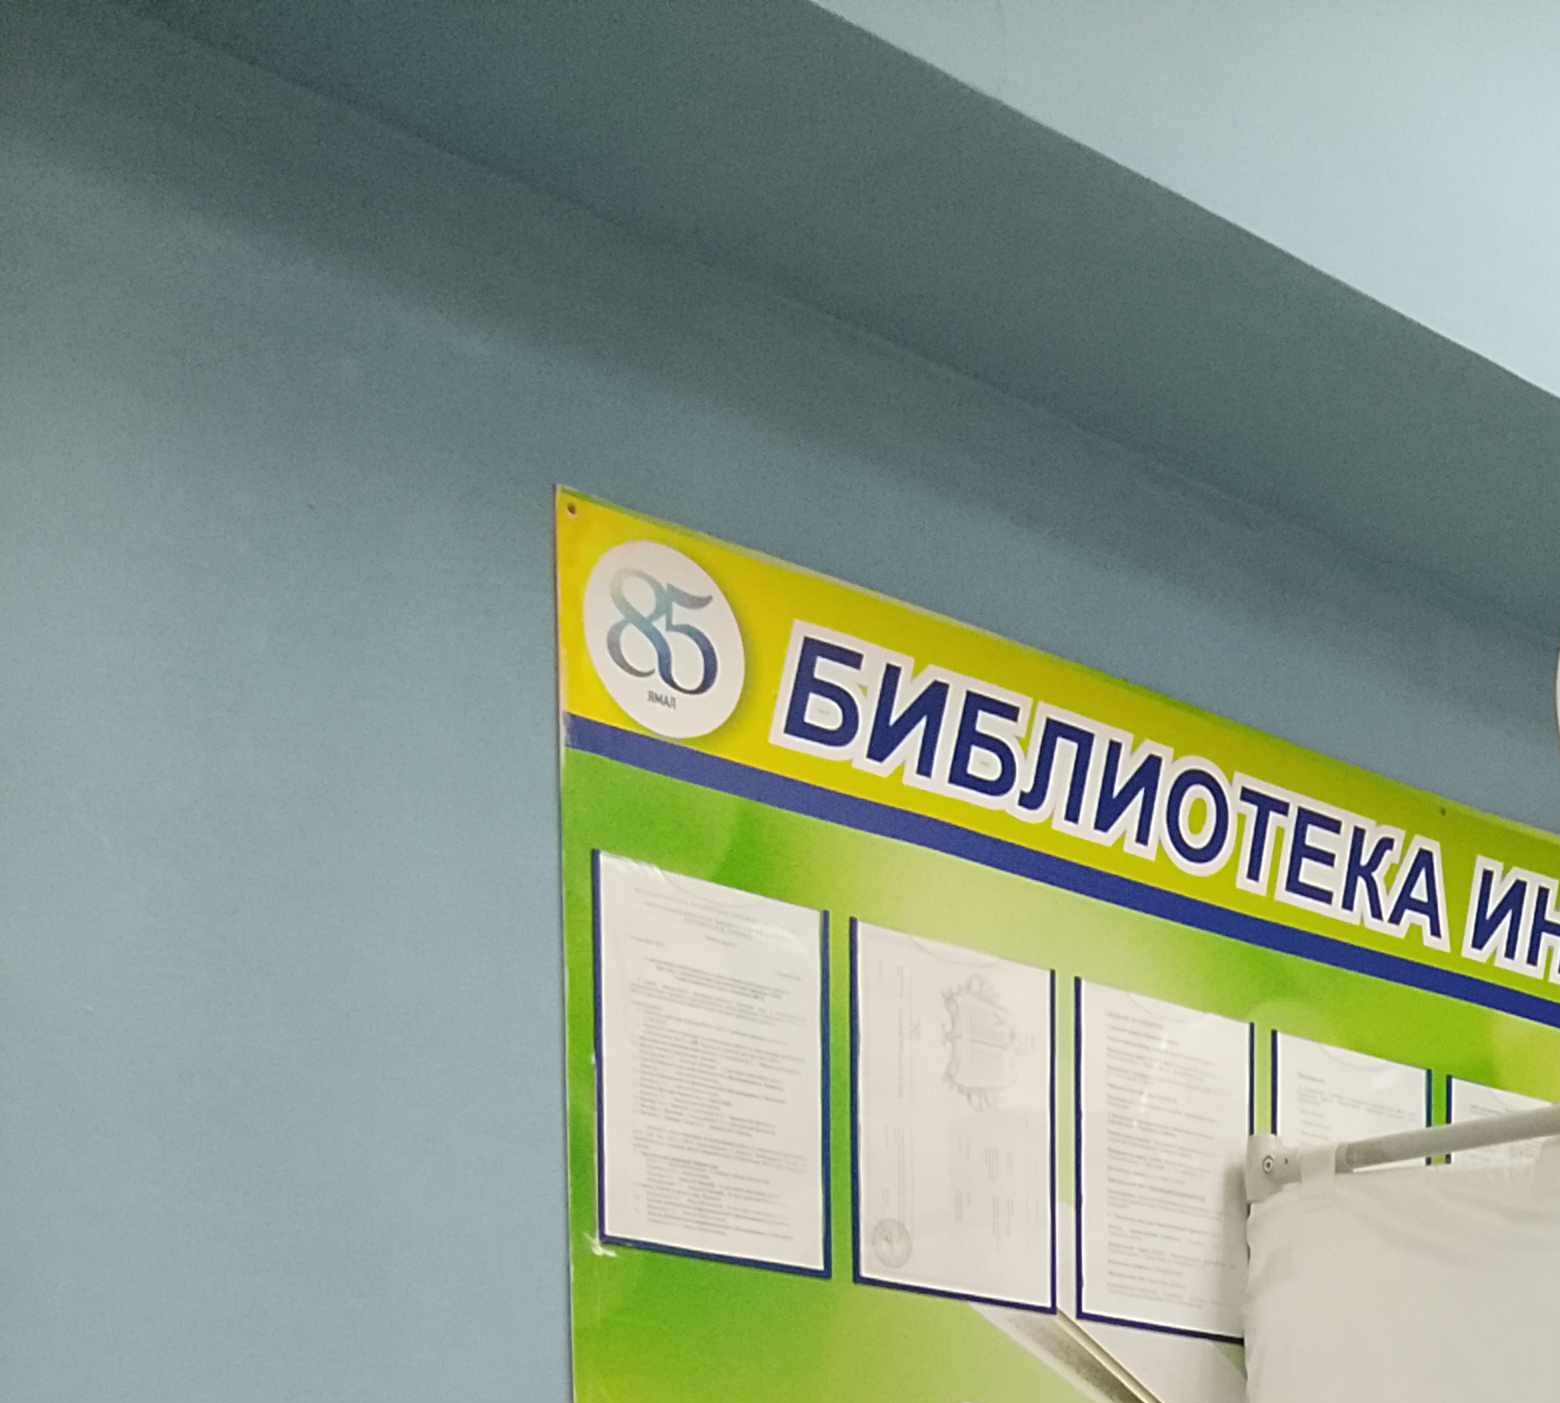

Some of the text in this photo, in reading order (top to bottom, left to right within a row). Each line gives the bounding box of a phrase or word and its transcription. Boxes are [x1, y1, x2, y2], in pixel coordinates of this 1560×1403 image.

[605, 569, 718, 695] 85
[647, 690, 676, 710] ЯМАЛ
[783, 636, 1441, 938] БИБЛИОТЕКА
